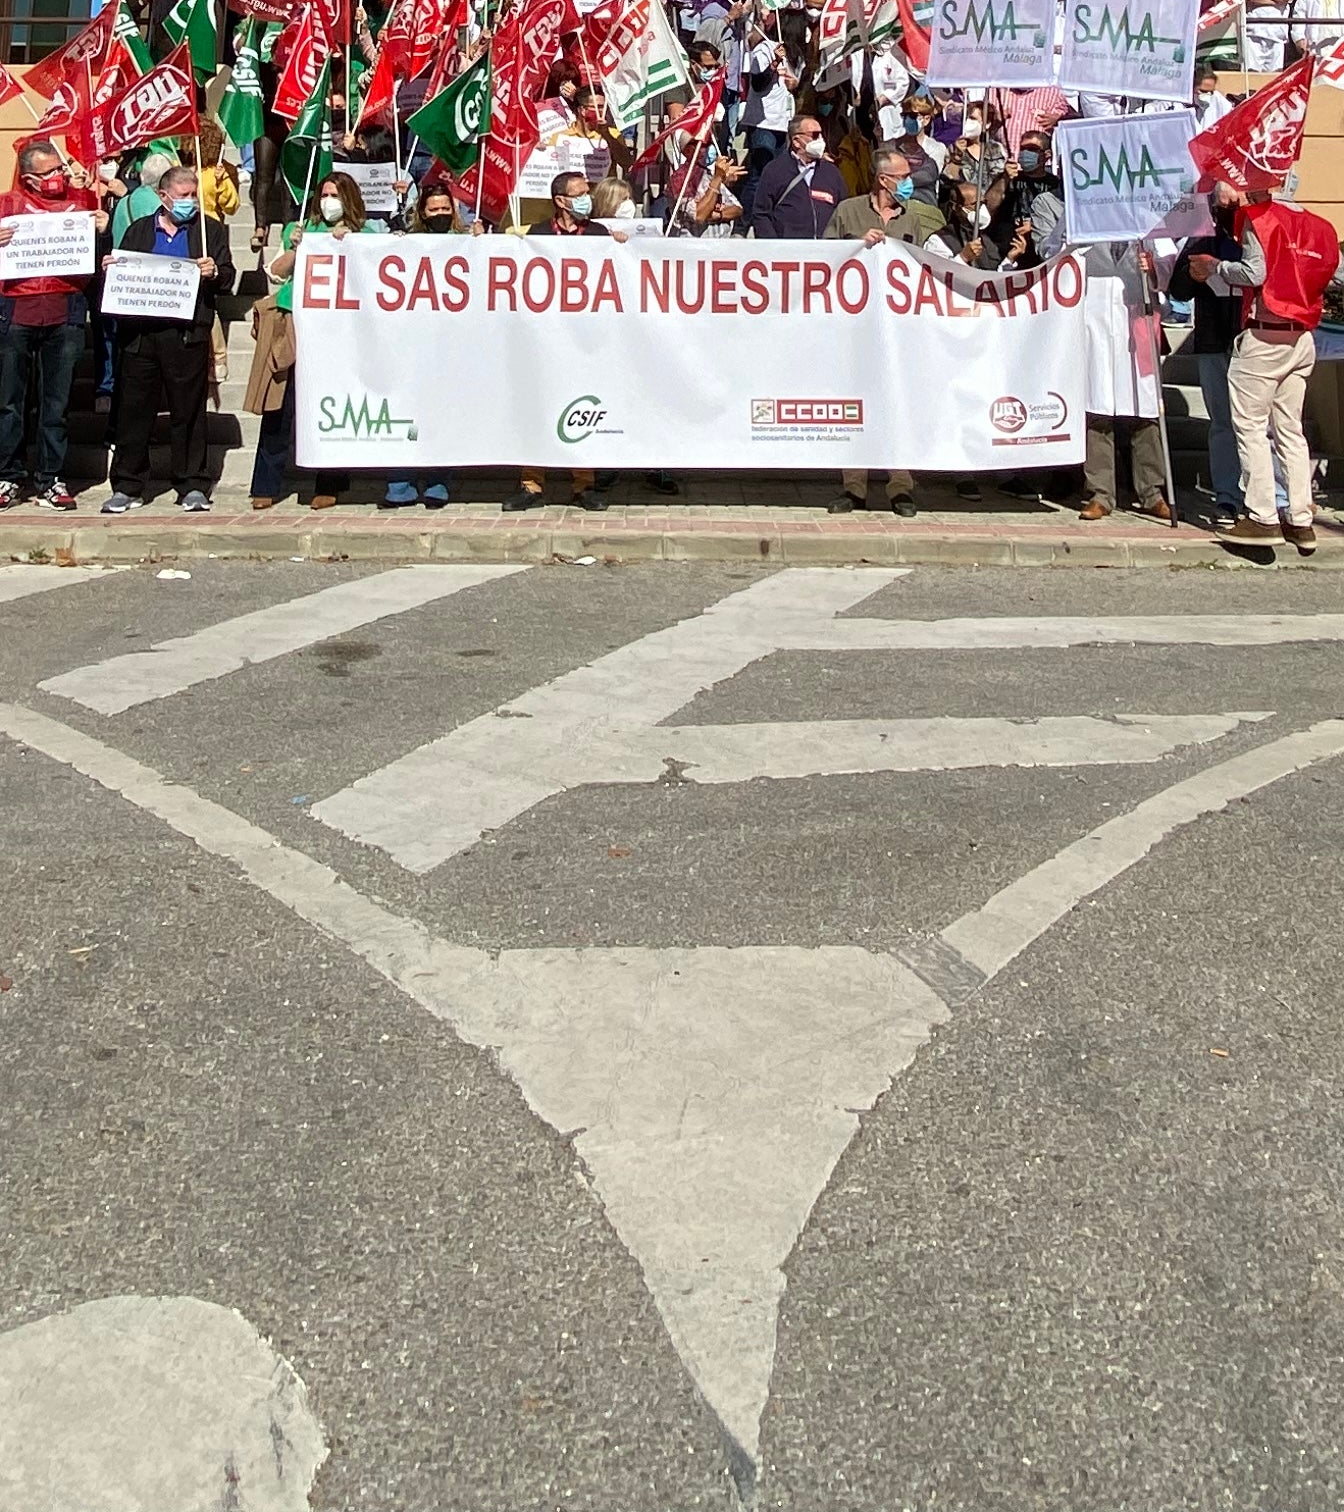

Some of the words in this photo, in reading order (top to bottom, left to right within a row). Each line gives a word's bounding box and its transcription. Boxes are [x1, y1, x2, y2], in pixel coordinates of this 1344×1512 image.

[1072, 2, 1156, 53] SMA
[1070, 143, 1159, 194] SMA
[116, 273, 152, 284] QUIENES
[302, 254, 361, 310] EL
[376, 255, 471, 313] SAS
[487, 256, 625, 313] ROBA
[640, 258, 870, 315] NUESTRO
[886, 253, 1083, 318] SALARIO
[125, 286, 178, 297] TRABAJADOR
[319, 392, 392, 437] SMA
[780, 404, 843, 420] CCOO
[993, 401, 1022, 418] UGT
[1028, 402, 1060, 412] Servicios
[567, 410, 607, 426] CSIF
